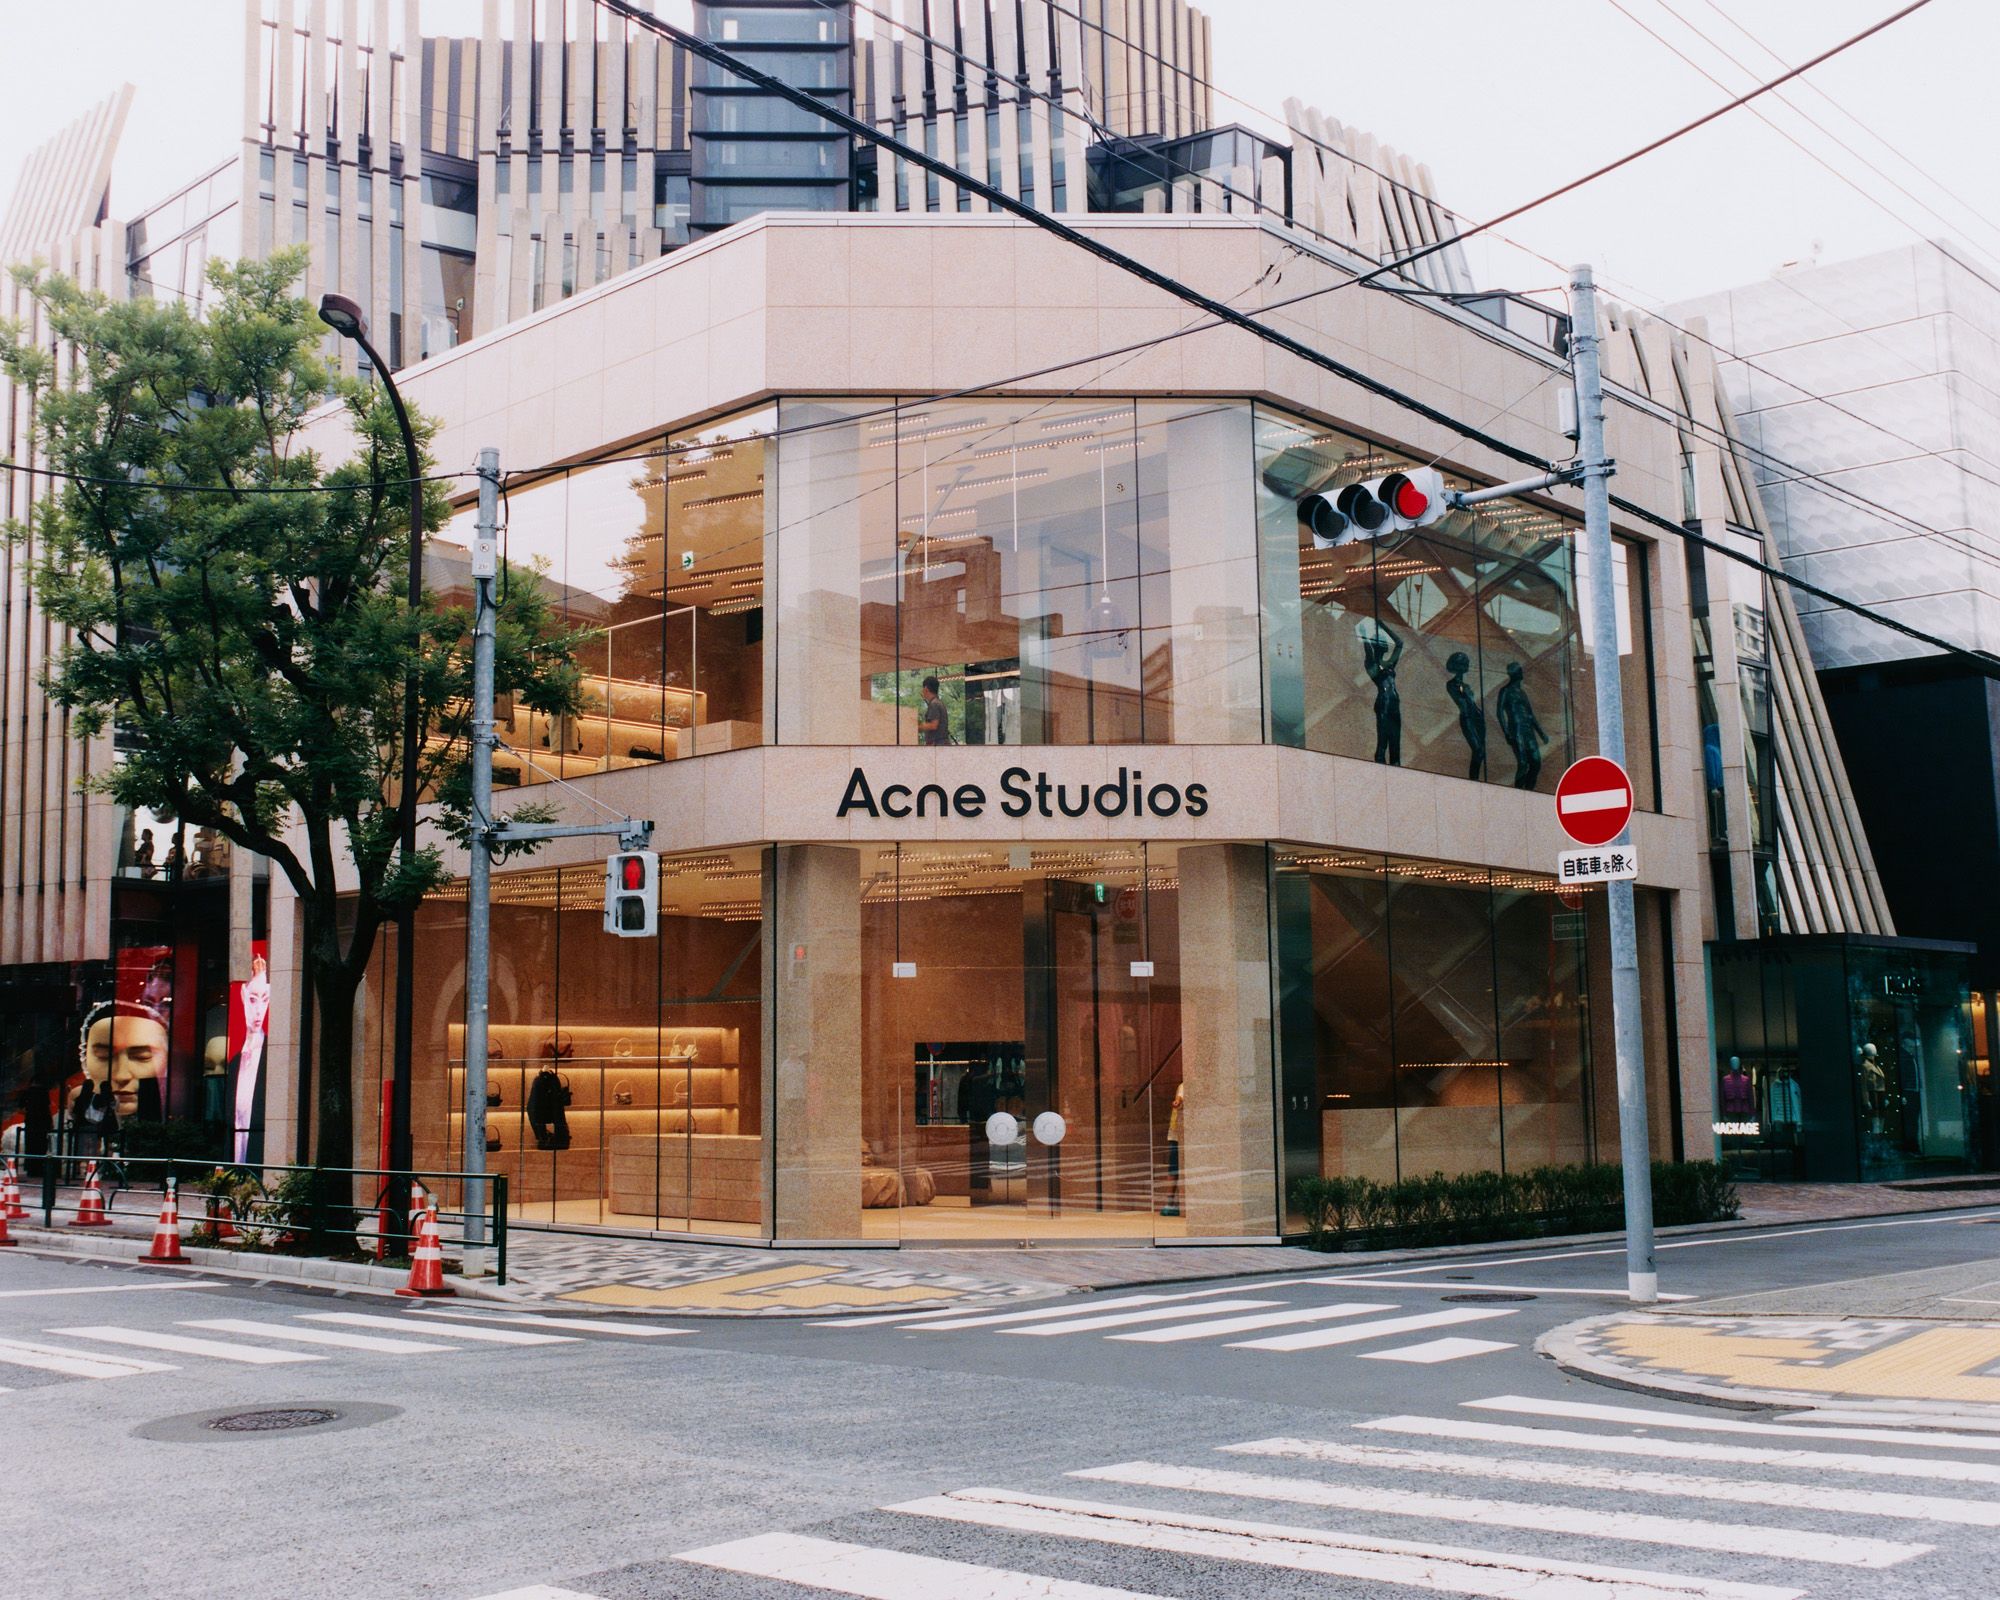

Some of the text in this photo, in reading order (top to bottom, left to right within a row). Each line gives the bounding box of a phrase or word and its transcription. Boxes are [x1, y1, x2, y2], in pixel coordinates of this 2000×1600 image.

[836, 767, 1209, 818] Acne Studios
[1564, 854, 1633, 877] 自転車を除く
